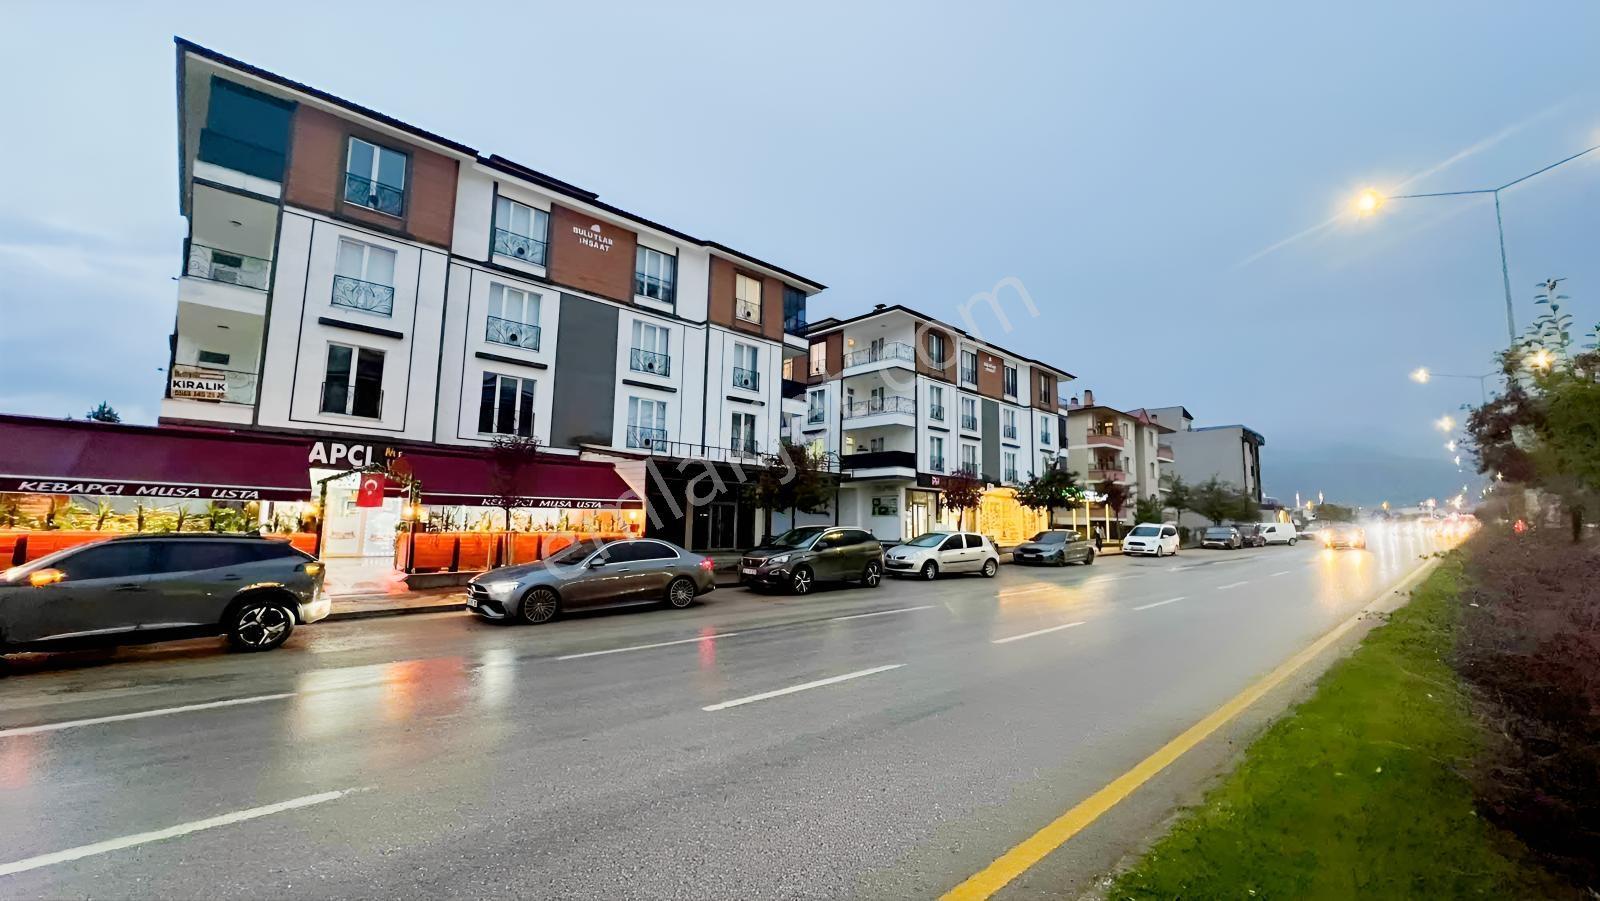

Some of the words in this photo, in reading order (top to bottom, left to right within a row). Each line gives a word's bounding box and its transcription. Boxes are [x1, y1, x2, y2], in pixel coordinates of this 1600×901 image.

[172, 380, 226, 391] KIRALIK
[135, 485, 200, 497] MUSA
[211, 488, 259, 499] USTA
[539, 500, 572, 508] MUSA
[576, 501, 602, 509] USTA
